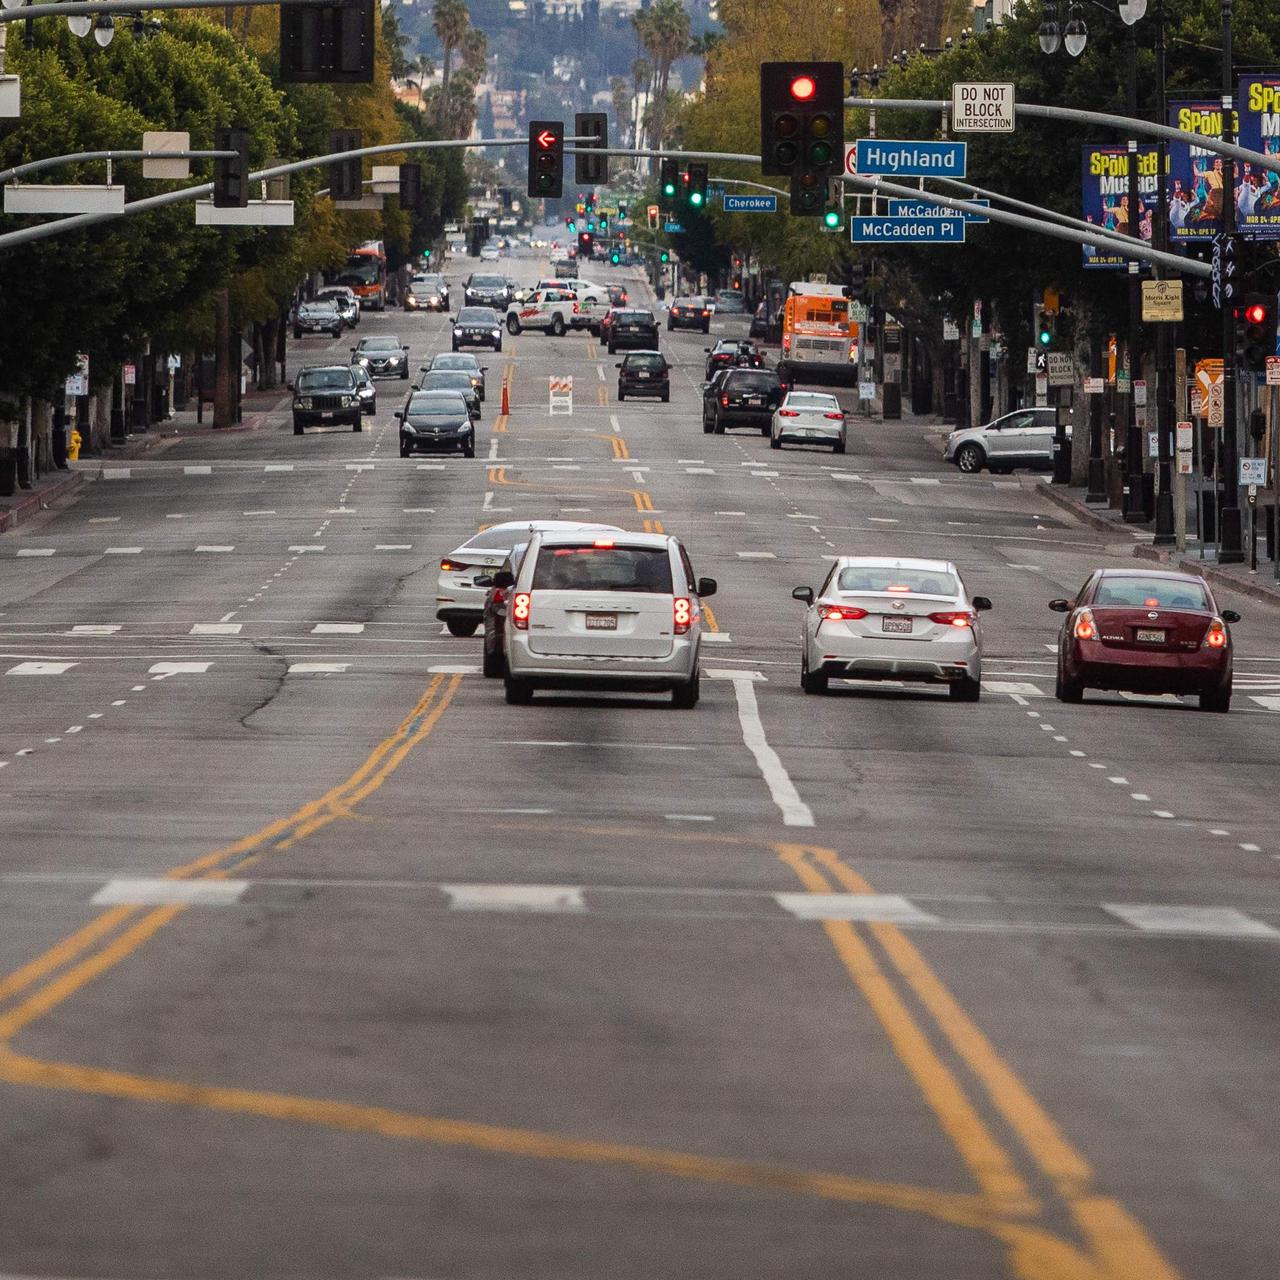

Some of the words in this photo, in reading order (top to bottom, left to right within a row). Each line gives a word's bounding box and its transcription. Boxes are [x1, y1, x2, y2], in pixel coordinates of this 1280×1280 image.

[961, 87, 978, 101] DO
[983, 87, 1006, 101] NOT
[964, 103, 1003, 117] BLOCK
[956, 118, 1012, 128] INTERSECTION
[866, 148, 955, 171] Highland
[728, 198, 771, 208] Cherokee
[862, 223, 935, 236] McCadden
[941, 223, 954, 236] Pl
